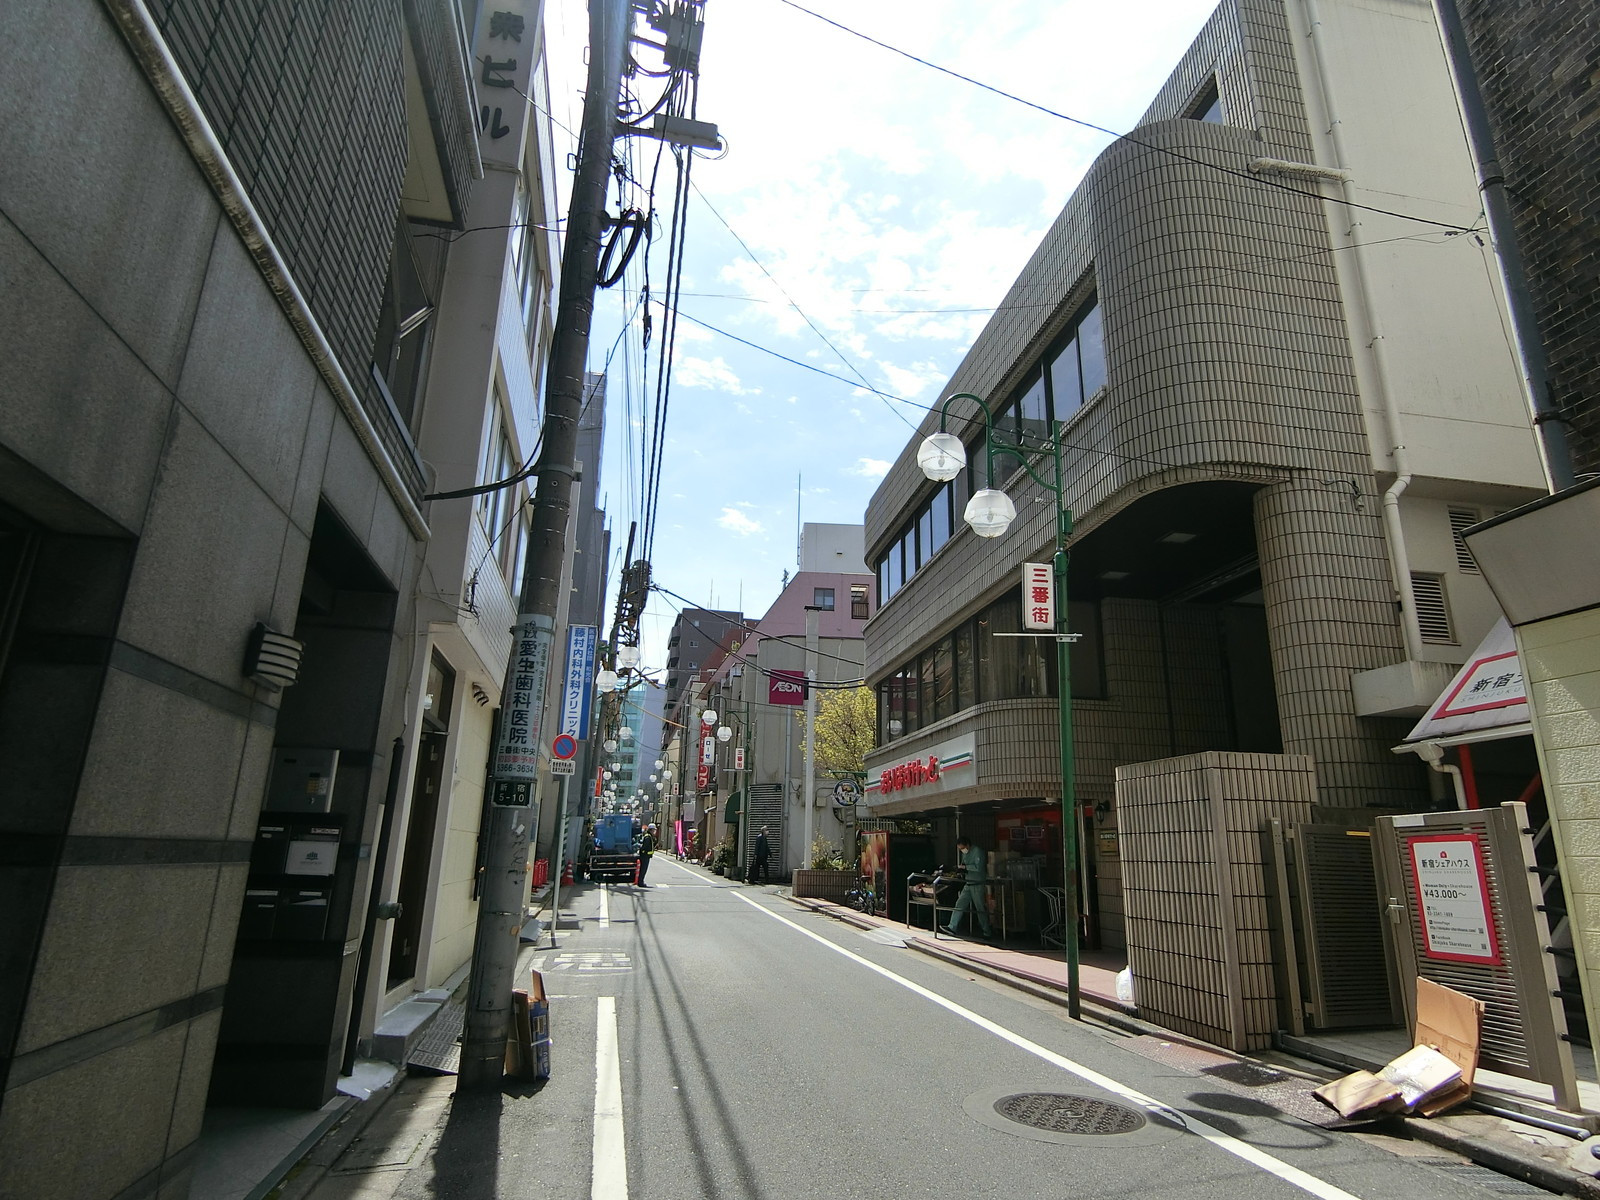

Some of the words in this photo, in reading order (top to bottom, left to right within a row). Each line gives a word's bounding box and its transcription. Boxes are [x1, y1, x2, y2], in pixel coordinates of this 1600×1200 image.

[1032, 568, 1049, 623] 三番街
[567, 628, 586, 736] 藤村内科外科クリニック
[508, 640, 537, 744] 愛生歯科医院
[1461, 687, 1521, 703] SHINJUKU
[499, 746, 536, 755] 三番街中央
[497, 764, 533, 773] 5366-3634
[499, 793, 524, 802] 5-10
[1421, 859, 1470, 868] 新宿シェアハウス
